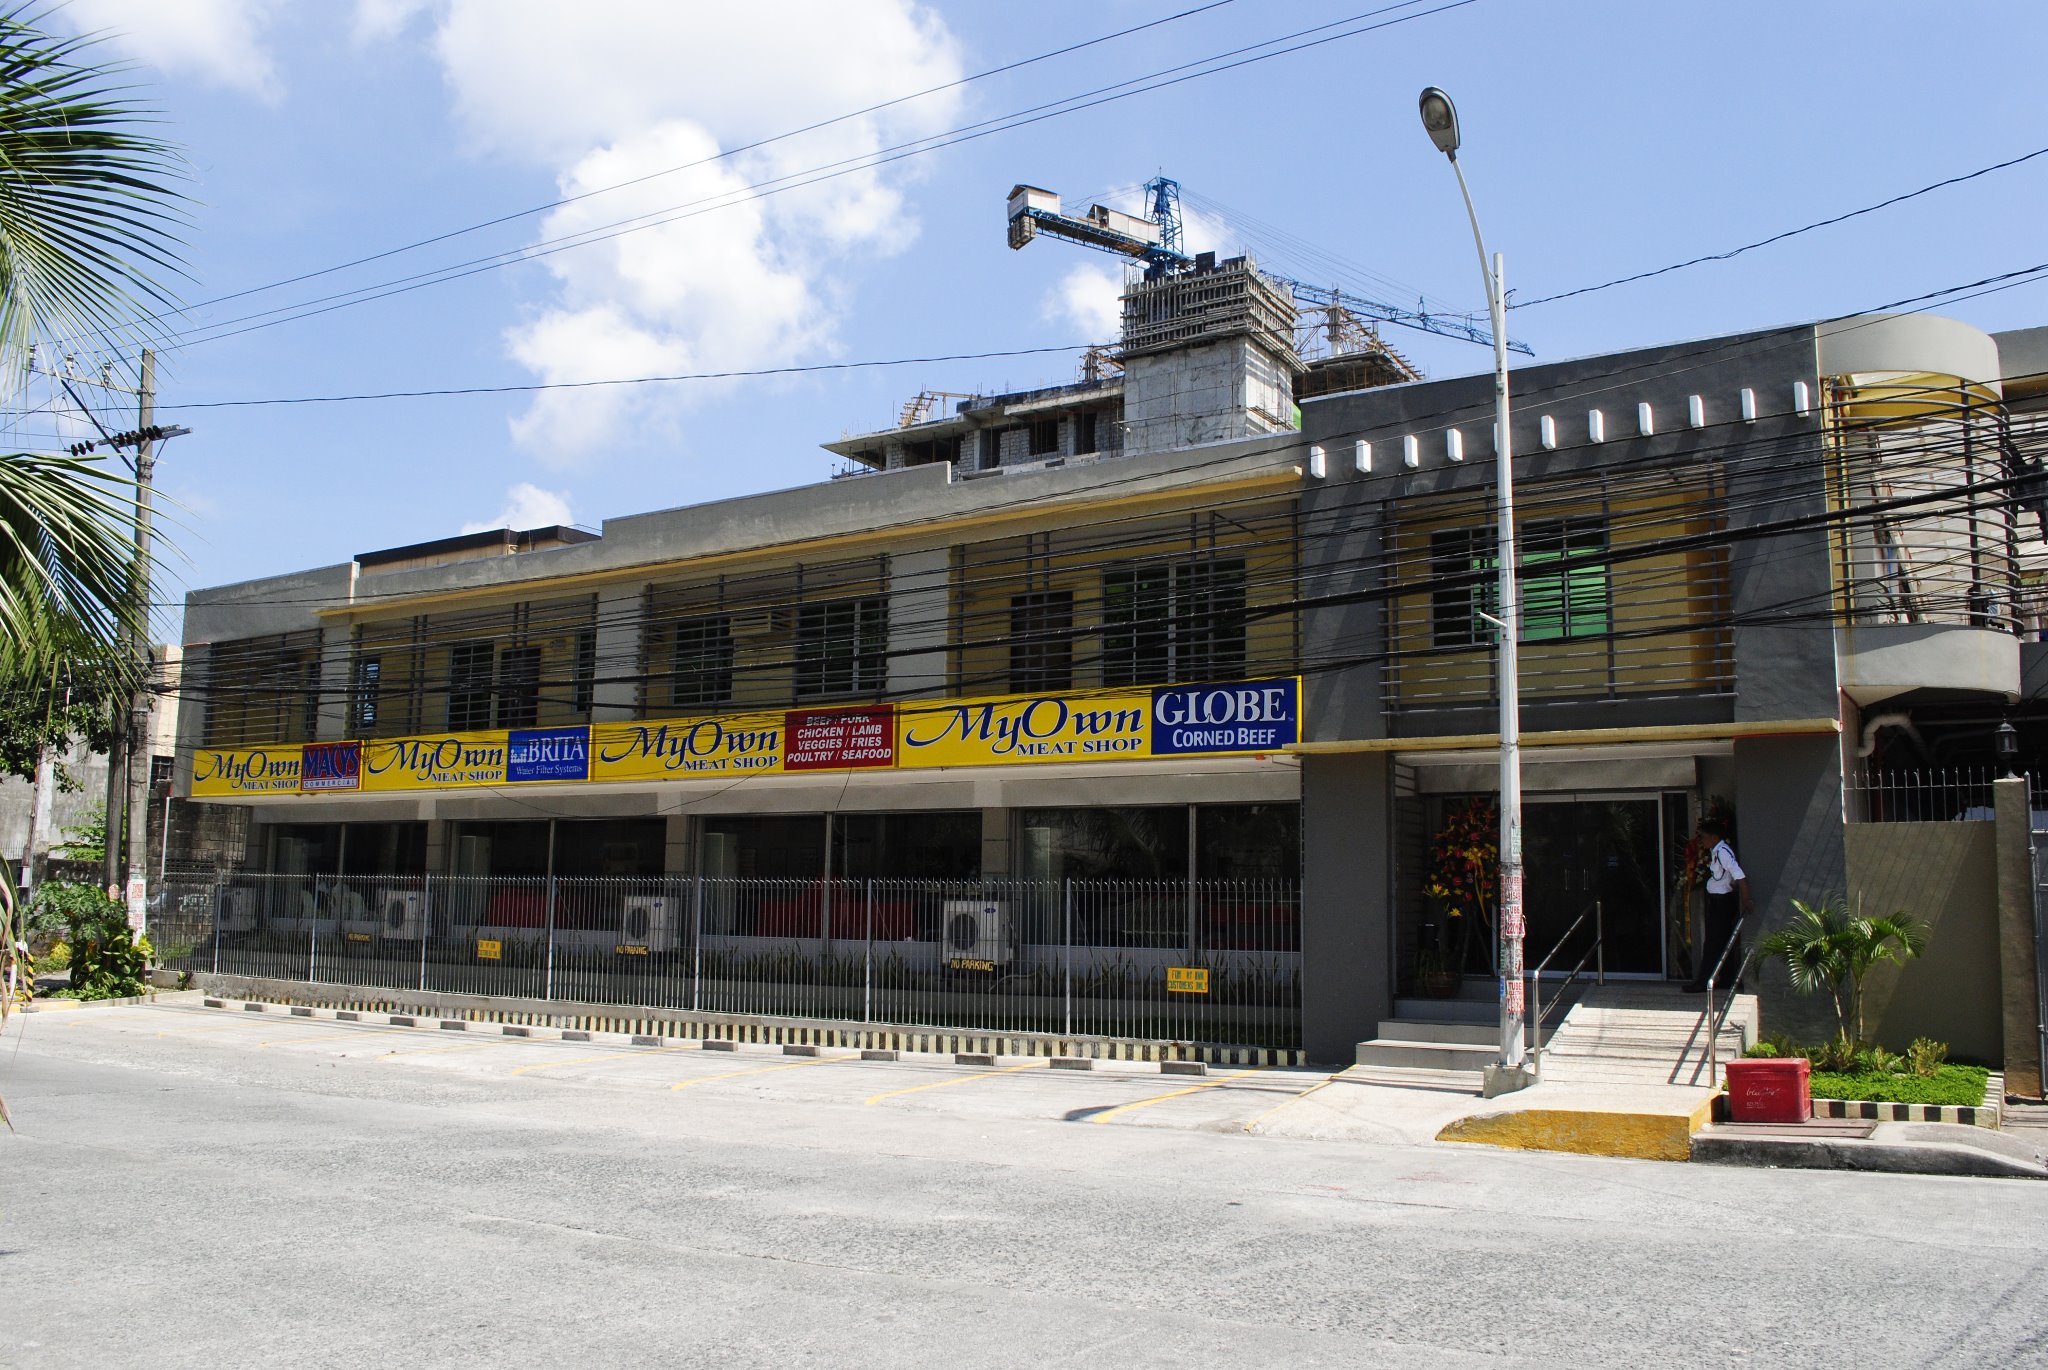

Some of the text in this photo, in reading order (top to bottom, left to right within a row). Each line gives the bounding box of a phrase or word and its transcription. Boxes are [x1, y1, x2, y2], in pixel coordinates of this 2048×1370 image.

[1155, 688, 1286, 726] GLOBE
[797, 727, 844, 738] CHICKEN
[852, 725, 882, 736] LAMB
[527, 736, 585, 763] BRITA
[798, 739, 842, 750] VEGGIES
[851, 737, 882, 748] FRIES
[1016, 738, 1143, 756] MEAT SHOP
[787, 751, 834, 762] POULTRY
[842, 748, 892, 760] SEAFOOD
[536, 765, 553, 775] Filter
[555, 764, 583, 775] Systems
[684, 755, 778, 771] MEAT SHOP
[432, 770, 503, 783] MEAT SHOP
[242, 779, 299, 790] MEAT SHOP
[304, 780, 355, 788] COMMERCIAL
[950, 959, 994, 972] NO PARKING
